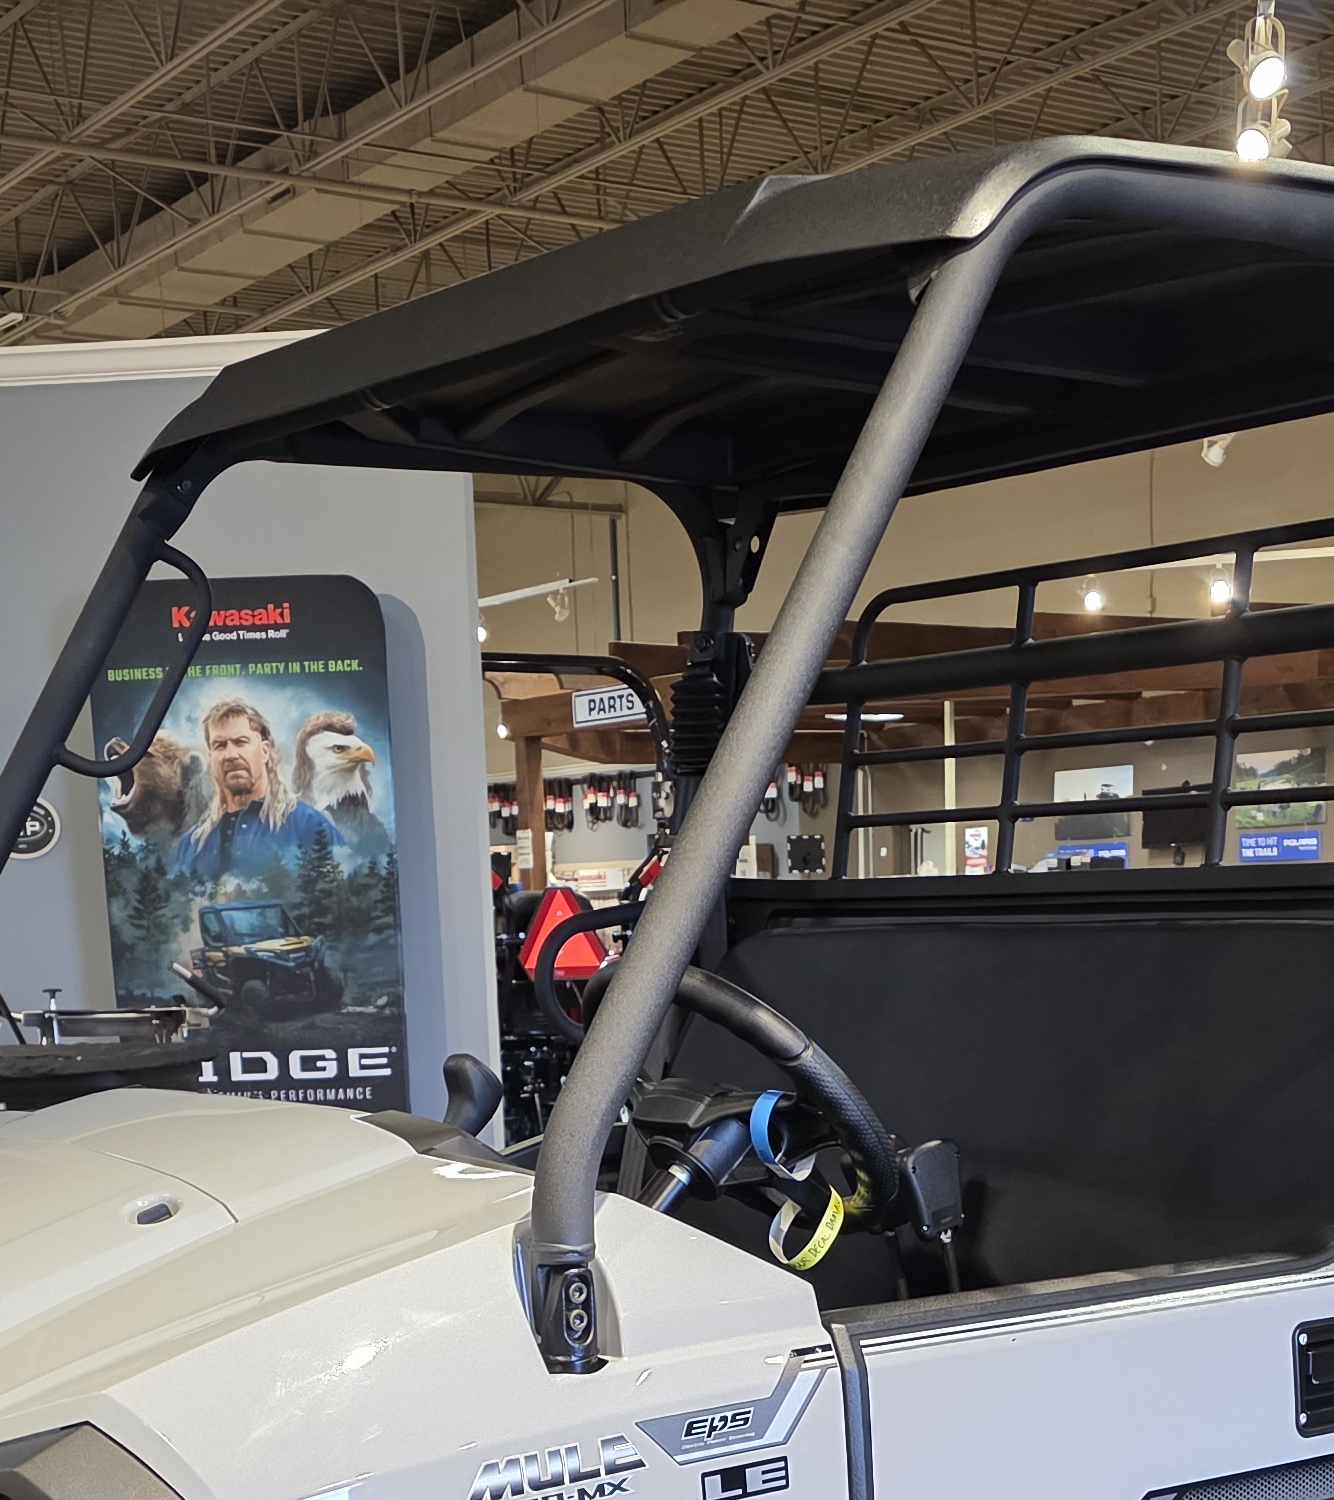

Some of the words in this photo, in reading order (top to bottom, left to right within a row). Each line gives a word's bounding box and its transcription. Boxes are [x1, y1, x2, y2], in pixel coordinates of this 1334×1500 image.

[171, 603, 290, 628] Kwasaki
[212, 630, 237, 641] Good
[238, 629, 266, 640] Times
[107, 667, 164, 682] BUSINESS
[184, 665, 202, 678] HE
[205, 664, 245, 677] FRONT.
[248, 662, 285, 675] PARTY
[289, 661, 301, 674] IN
[303, 660, 326, 673] THE
[328, 658, 363, 672] BACK.
[588, 693, 635, 716] PARTS
[199, 1046, 392, 1082] IDGE
[270, 1086, 373, 1101] PERFORMANCE
